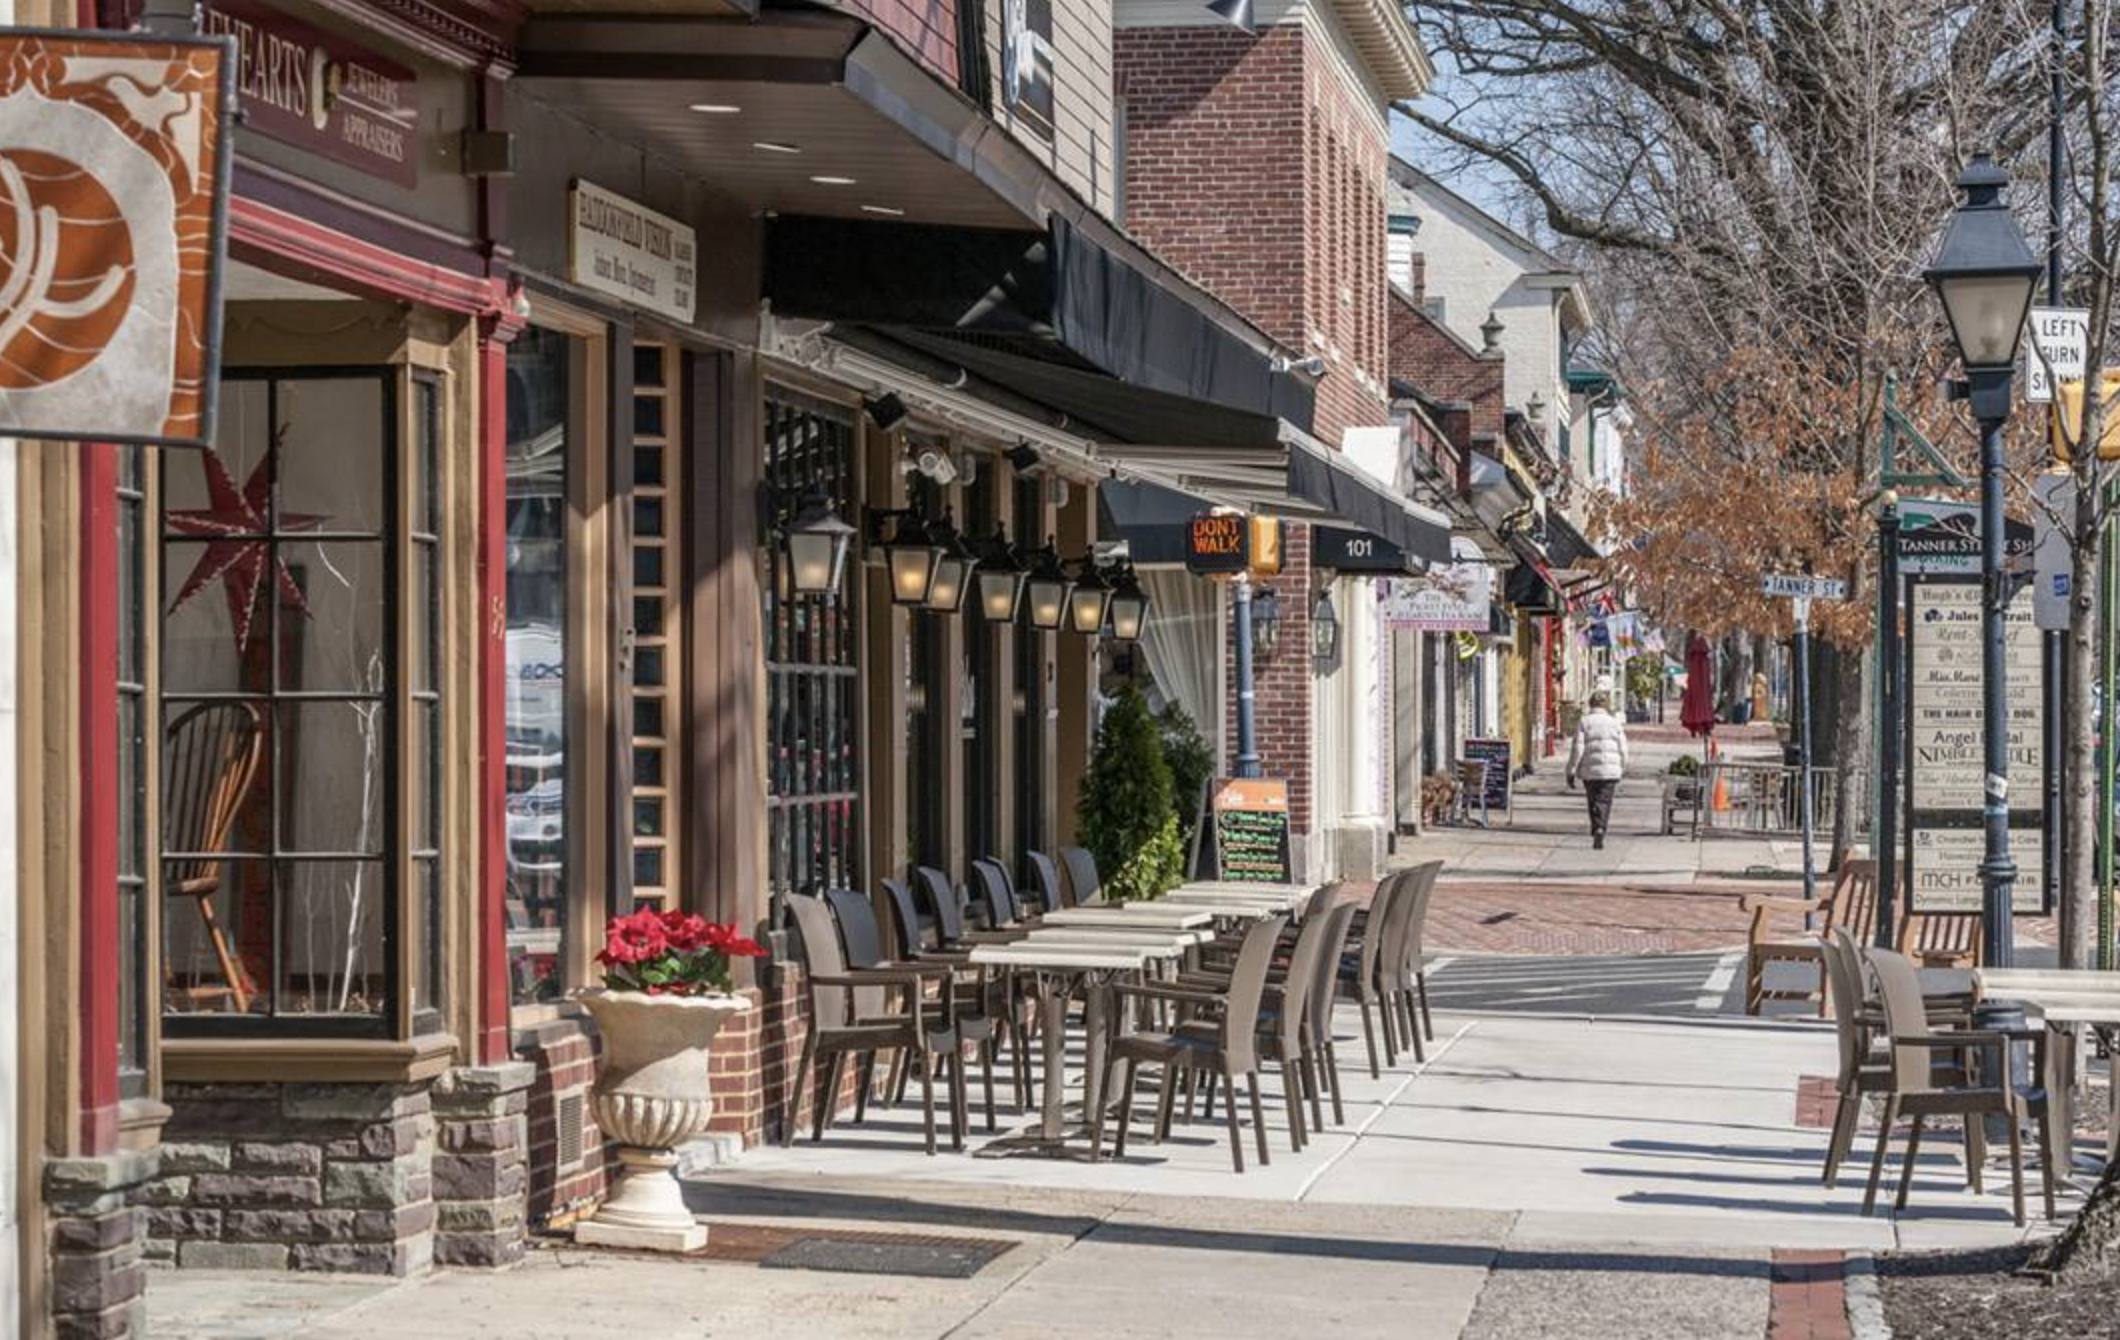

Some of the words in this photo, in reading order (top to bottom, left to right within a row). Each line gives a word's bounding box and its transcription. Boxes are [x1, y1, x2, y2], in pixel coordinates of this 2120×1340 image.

[2042, 319, 2076, 337] LEFT
[1193, 535, 1240, 554] WALK
[1345, 539, 1372, 557] 101
[1901, 539, 1958, 552] TANNER
[1773, 577, 1815, 594] TANNER
[1823, 582, 1835, 597] ST
[1947, 610, 1979, 621] Jules
[1933, 730, 1977, 748] Angel
[1917, 747, 1977, 763] NIMBLE
